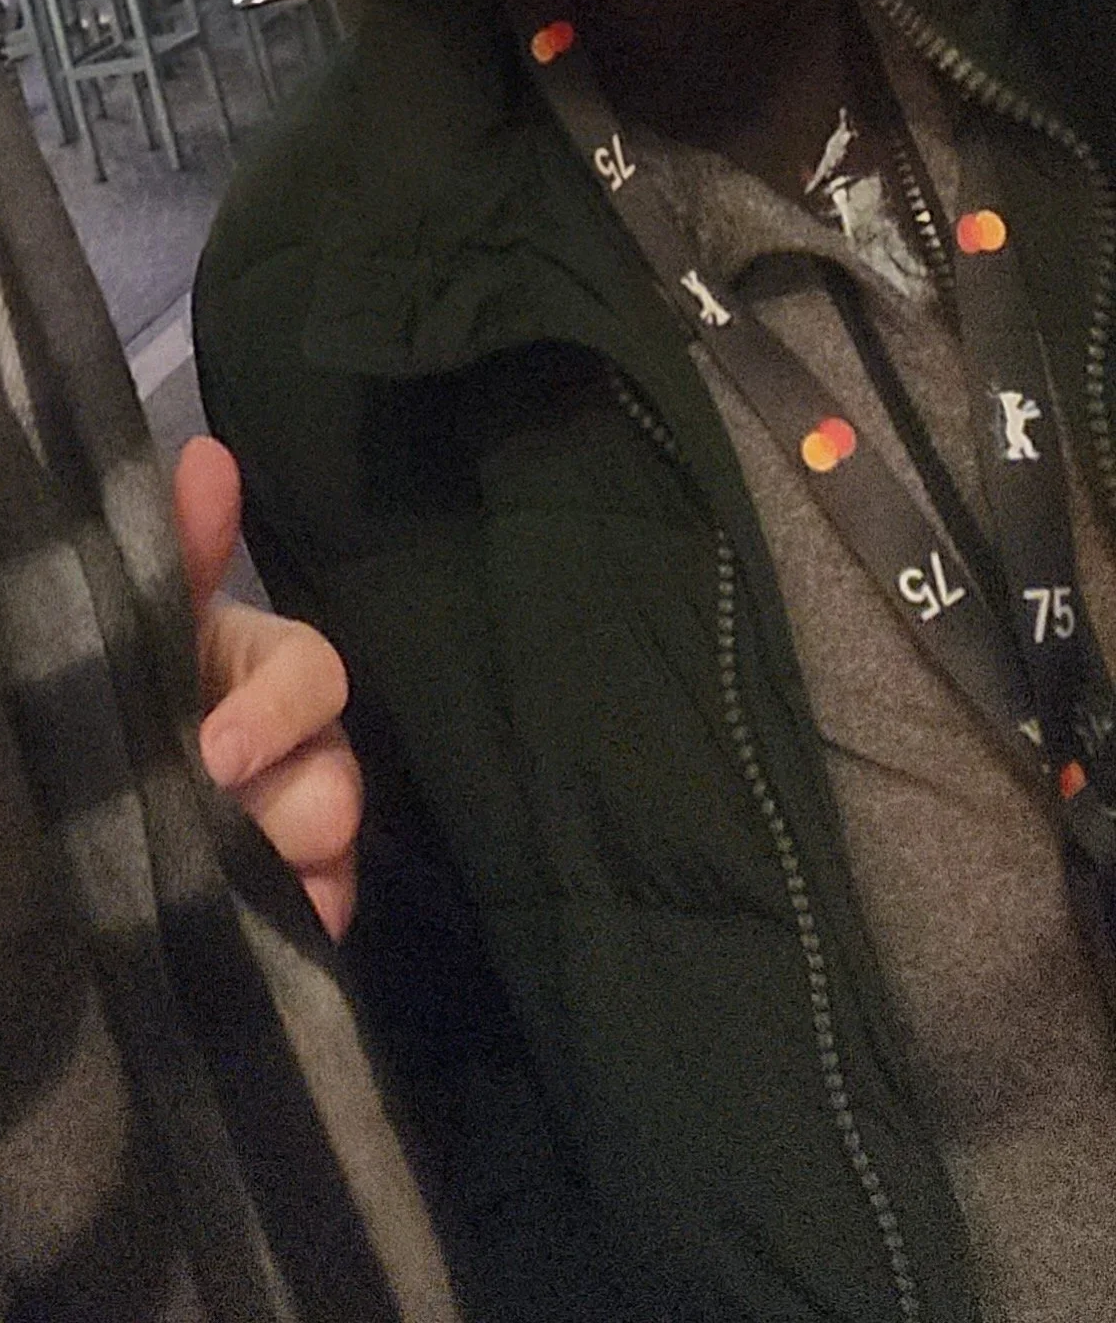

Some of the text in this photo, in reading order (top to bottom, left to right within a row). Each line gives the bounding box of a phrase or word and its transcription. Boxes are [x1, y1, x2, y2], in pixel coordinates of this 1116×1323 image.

[594, 133, 636, 192] 75
[898, 551, 966, 621] 75
[1023, 586, 1075, 644] 75
